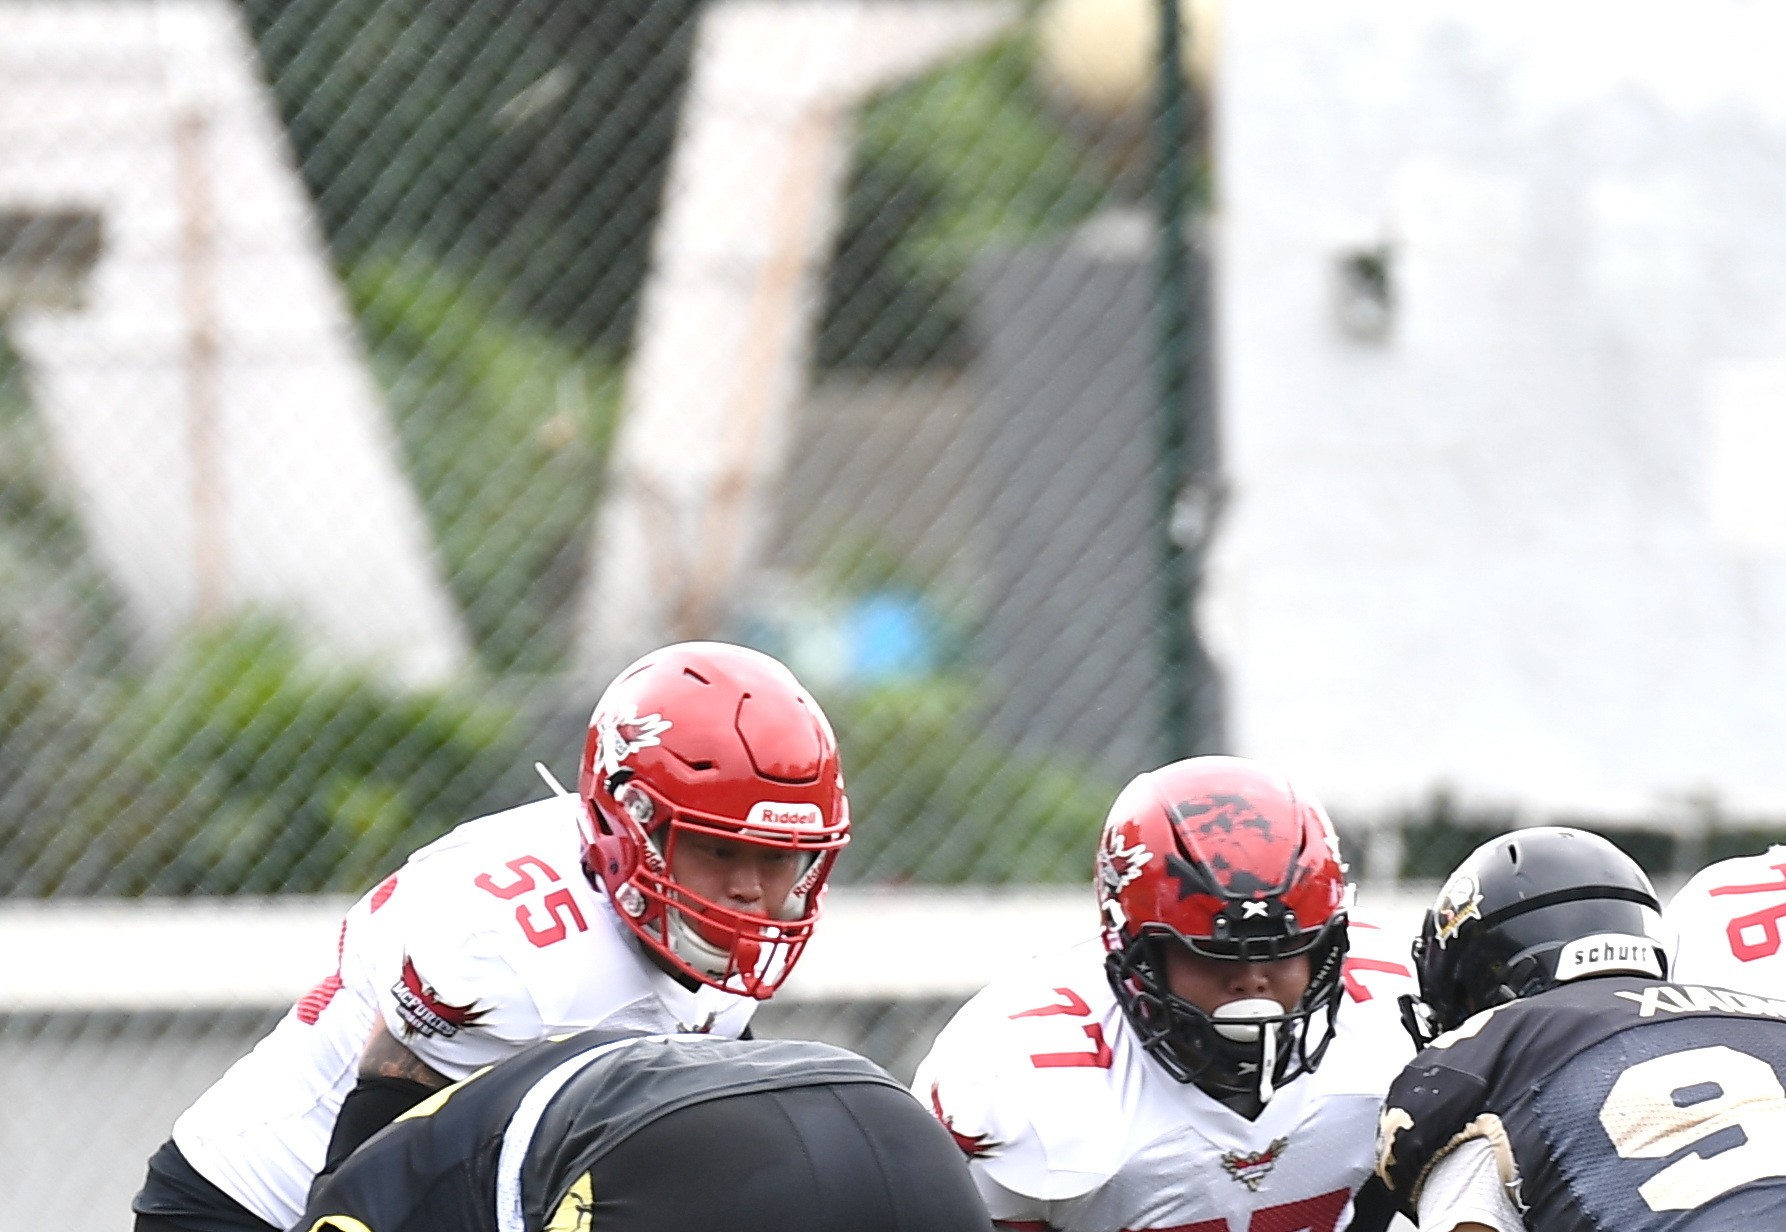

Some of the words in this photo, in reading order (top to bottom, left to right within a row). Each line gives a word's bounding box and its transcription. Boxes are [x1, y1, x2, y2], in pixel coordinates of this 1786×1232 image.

[761, 807, 817, 824] Riddell
[473, 854, 589, 948] 55
[1573, 940, 1649, 966] schutt
[1008, 986, 1114, 1070] 77
